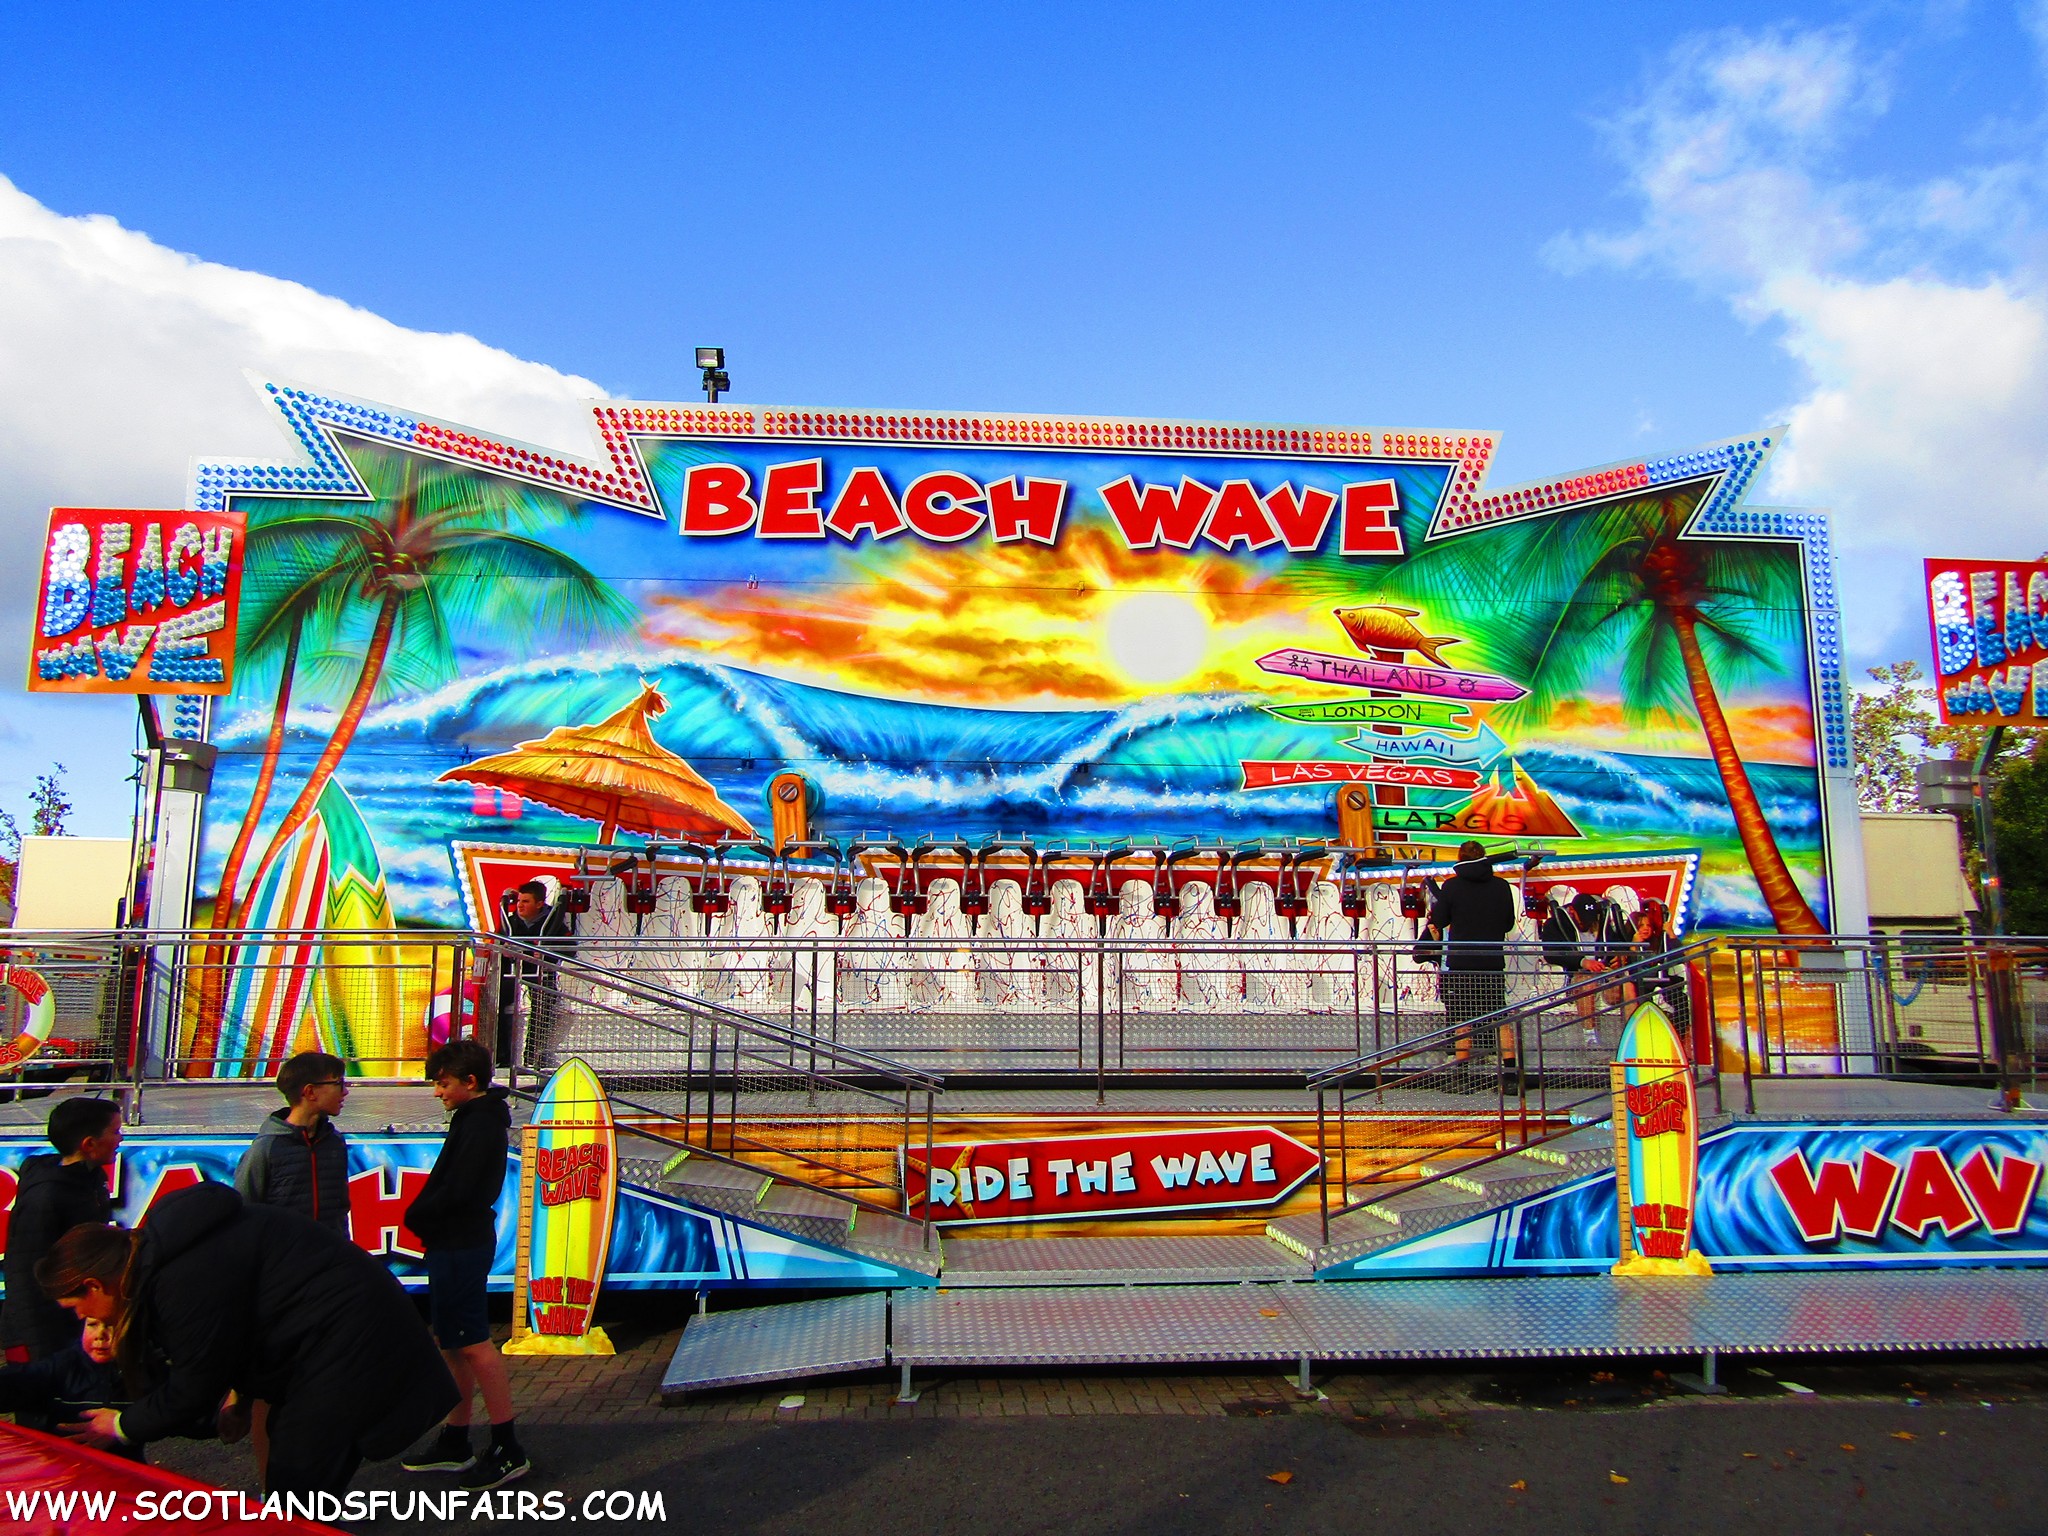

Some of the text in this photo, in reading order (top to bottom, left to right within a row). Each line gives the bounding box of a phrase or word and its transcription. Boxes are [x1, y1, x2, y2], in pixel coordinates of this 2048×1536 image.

[679, 457, 1405, 556] BEACH WAVE
[43, 522, 234, 638] BEACH
[37, 600, 226, 683] WAVE
[1317, 660, 1447, 690] THAILAND
[1322, 703, 1422, 721] LONDON
[1376, 738, 1455, 756] HAWAII
[1271, 763, 1453, 785] LAS VEGAS
[1383, 811, 1528, 832] LARGS
[8, 964, 48, 1007] WAVE
[1625, 1081, 1687, 1117] BEACH
[1632, 1102, 1685, 1138] WAVE
[537, 1143, 607, 1184] BEACH
[930, 1143, 1276, 1207] RIDE THE WAVE
[541, 1166, 602, 1206] WAVE
[1638, 1229, 1685, 1259] WAVE
[530, 1276, 595, 1305] RIDE THE
[534, 1304, 589, 1337] WAVE
